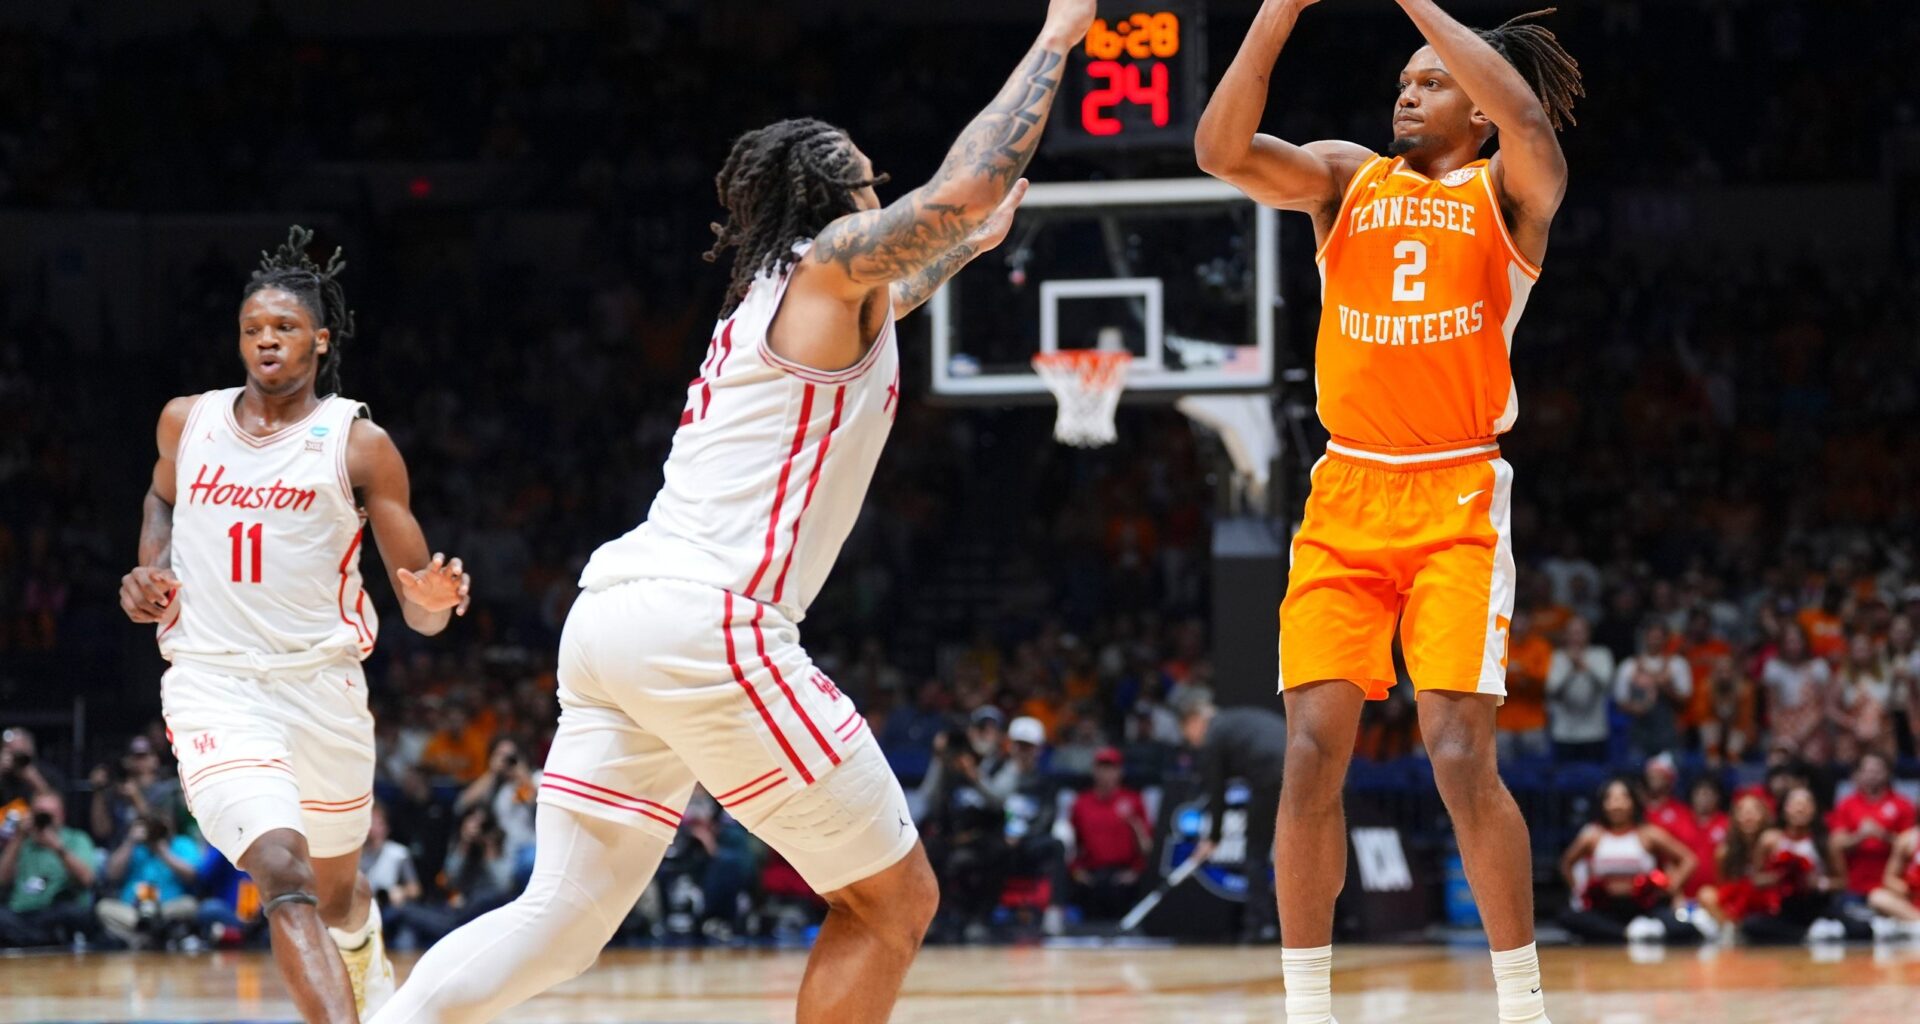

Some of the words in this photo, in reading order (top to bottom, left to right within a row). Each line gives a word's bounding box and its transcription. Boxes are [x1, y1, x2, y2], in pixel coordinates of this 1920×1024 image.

[1082, 60, 1169, 136] 24
[1349, 195, 1476, 237] TENNESSEE
[1392, 240, 1427, 302] 2
[1338, 300, 1484, 346] VOLUNTEERS
[189, 464, 317, 512] Houston
[228, 521, 263, 583] 11
